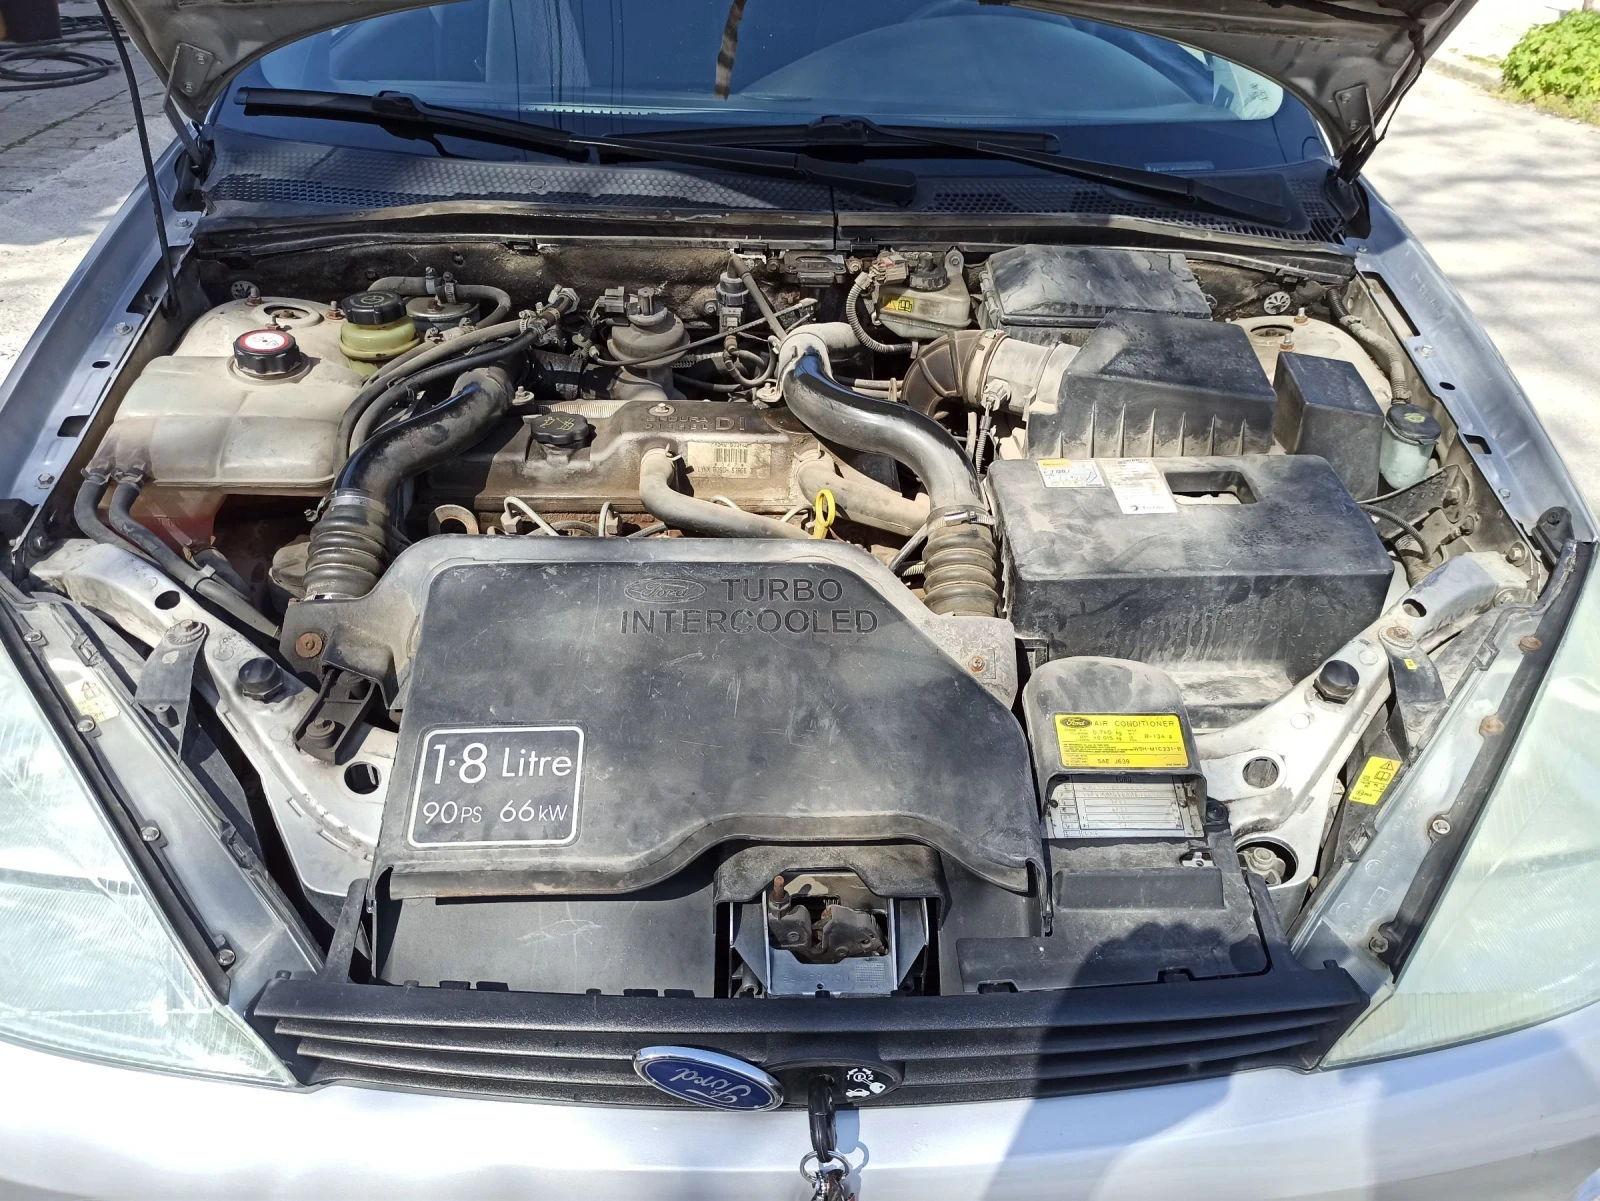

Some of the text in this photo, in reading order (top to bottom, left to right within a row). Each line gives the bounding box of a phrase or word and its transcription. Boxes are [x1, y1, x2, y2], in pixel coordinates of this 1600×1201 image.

[645, 415, 708, 423] ENDURA
[720, 578, 843, 602] TURBO
[620, 608, 878, 634] INTERCOOLED
[1114, 720, 1175, 728] CONDITIONER
[502, 747, 573, 777] Litre
[669, 1068, 752, 1104] Ford
